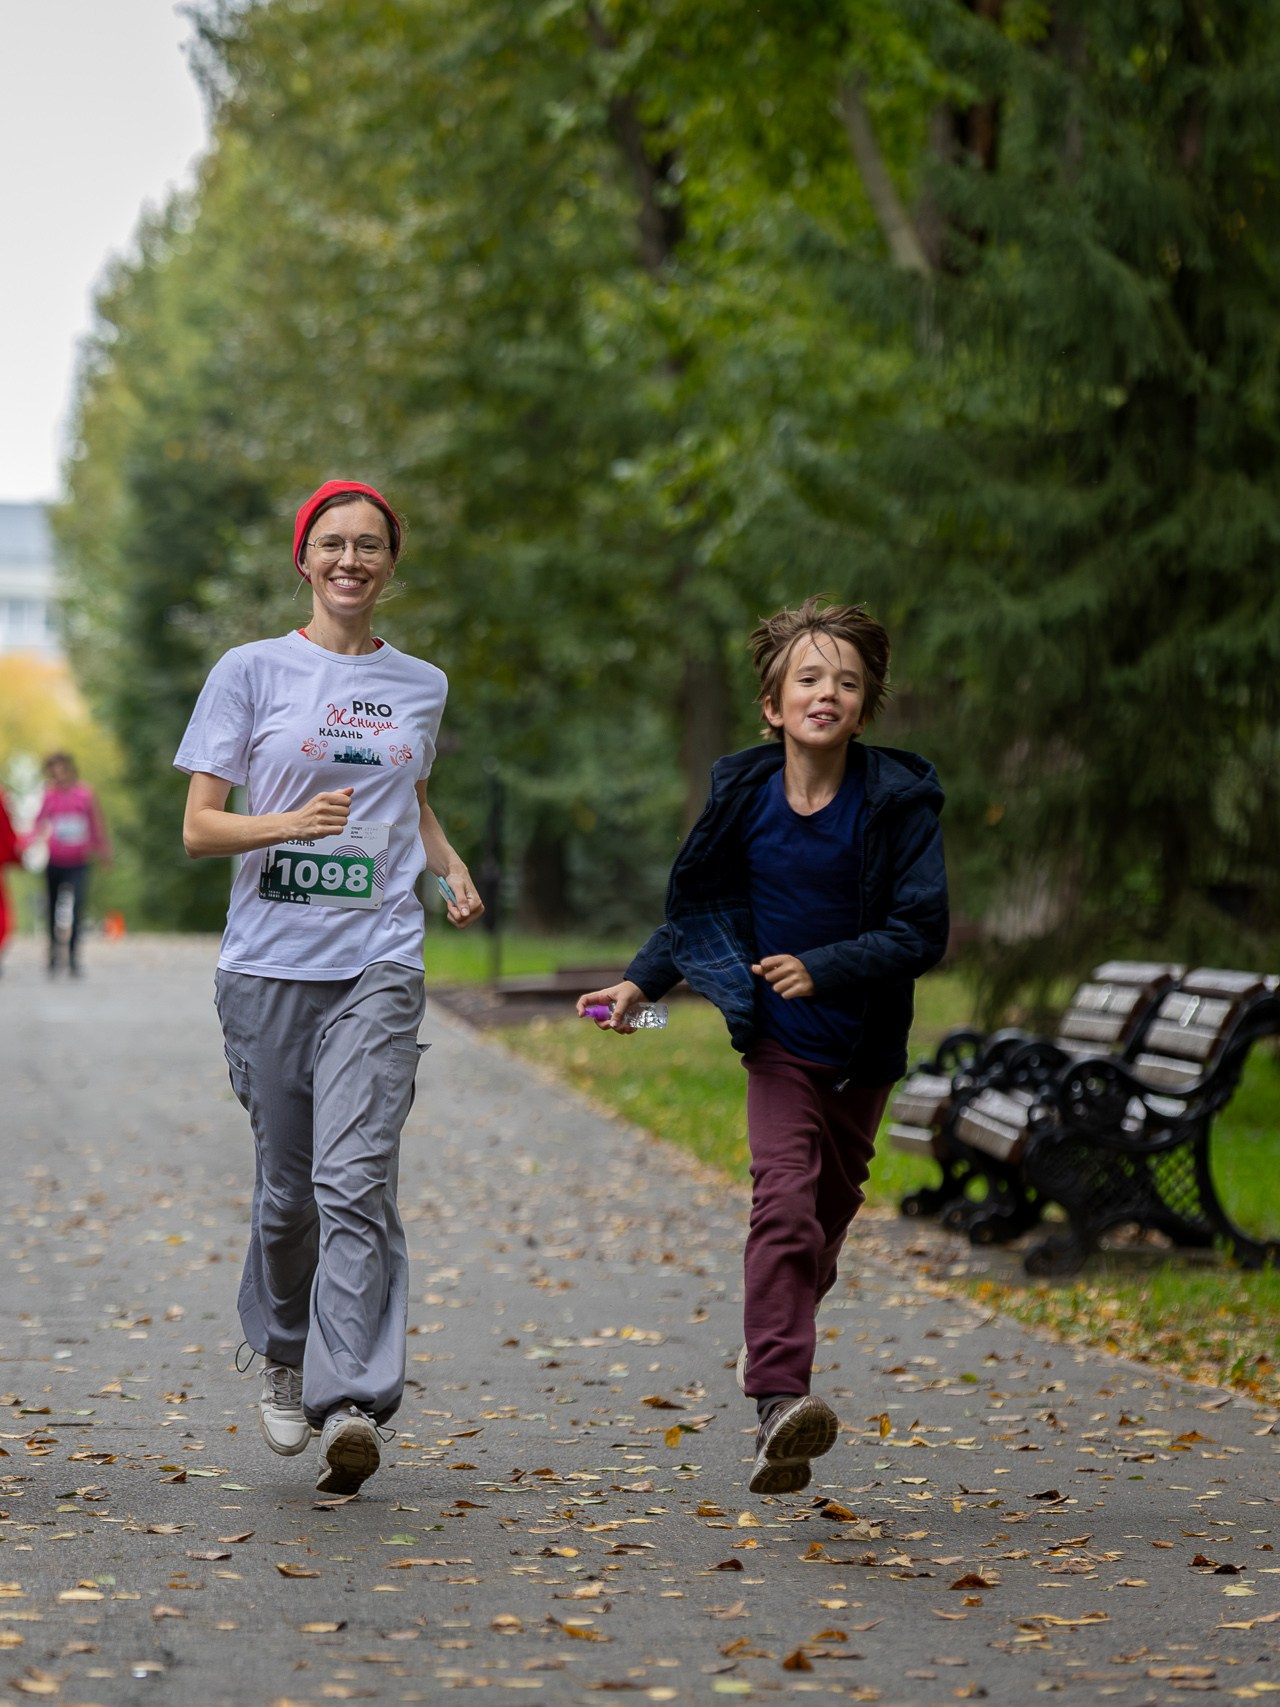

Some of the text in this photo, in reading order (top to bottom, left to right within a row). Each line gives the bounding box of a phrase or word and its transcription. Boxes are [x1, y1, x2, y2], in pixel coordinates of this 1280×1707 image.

[326, 703, 398, 736] Женщин
[352, 700, 393, 718] PRO
[318, 727, 363, 740] КАЗАНЬ
[276, 858, 369, 892] 1098
